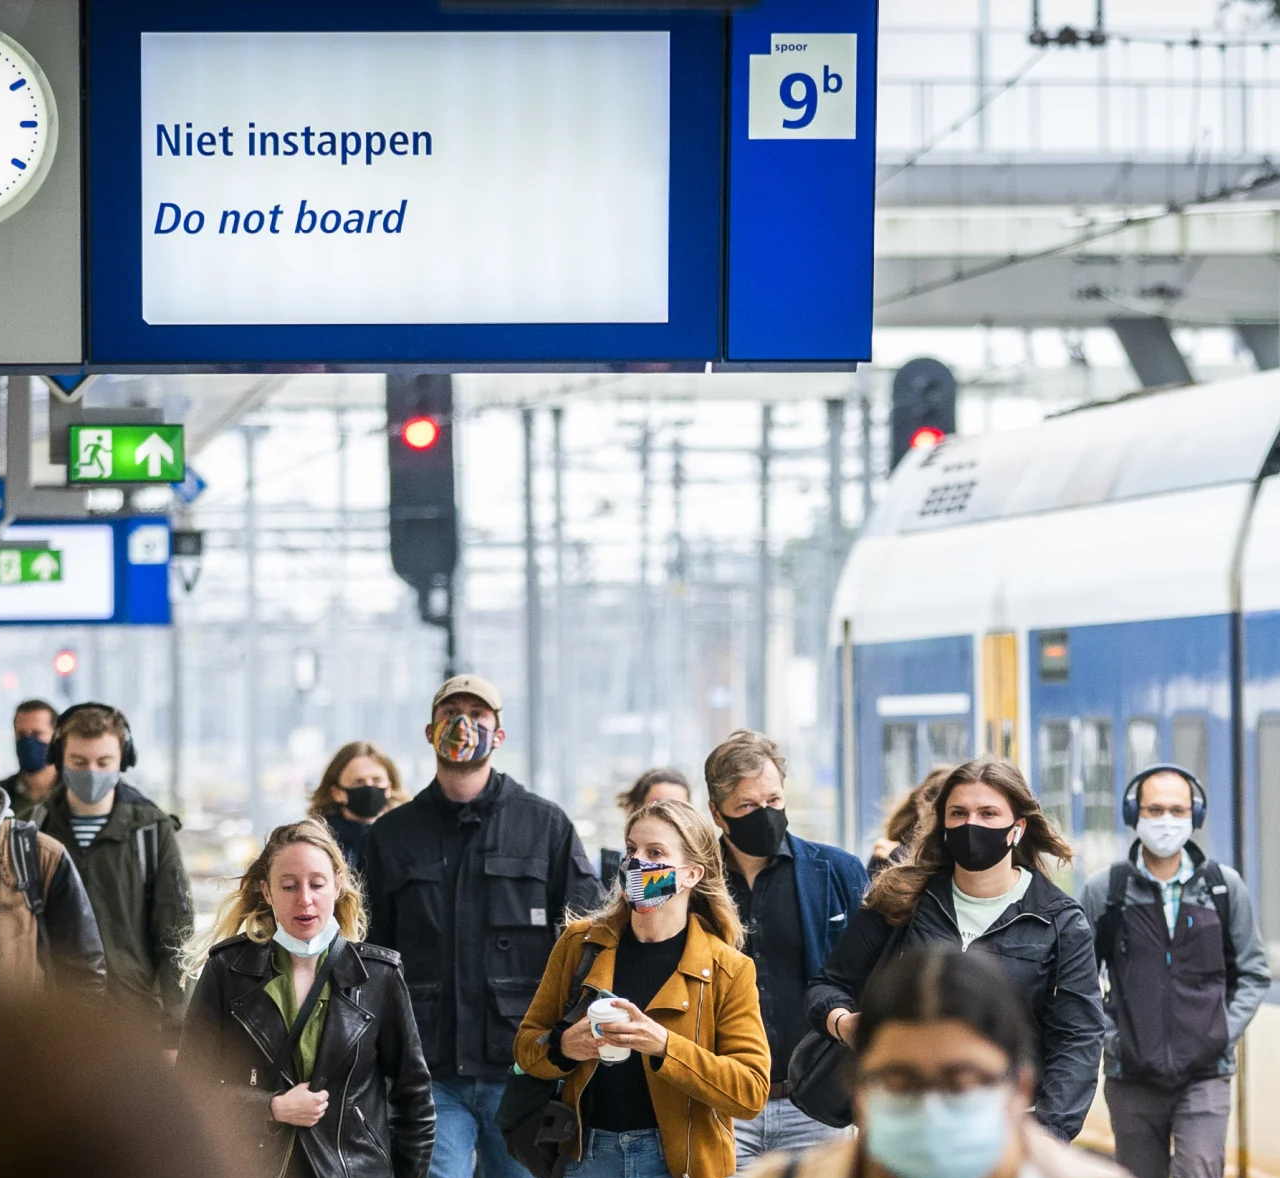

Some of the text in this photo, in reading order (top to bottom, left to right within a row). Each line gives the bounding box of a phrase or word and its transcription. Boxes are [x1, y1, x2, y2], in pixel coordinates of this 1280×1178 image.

[774, 43, 809, 54] spoor
[156, 122, 433, 166] Niet instappen
[153, 199, 408, 235] Do not board
